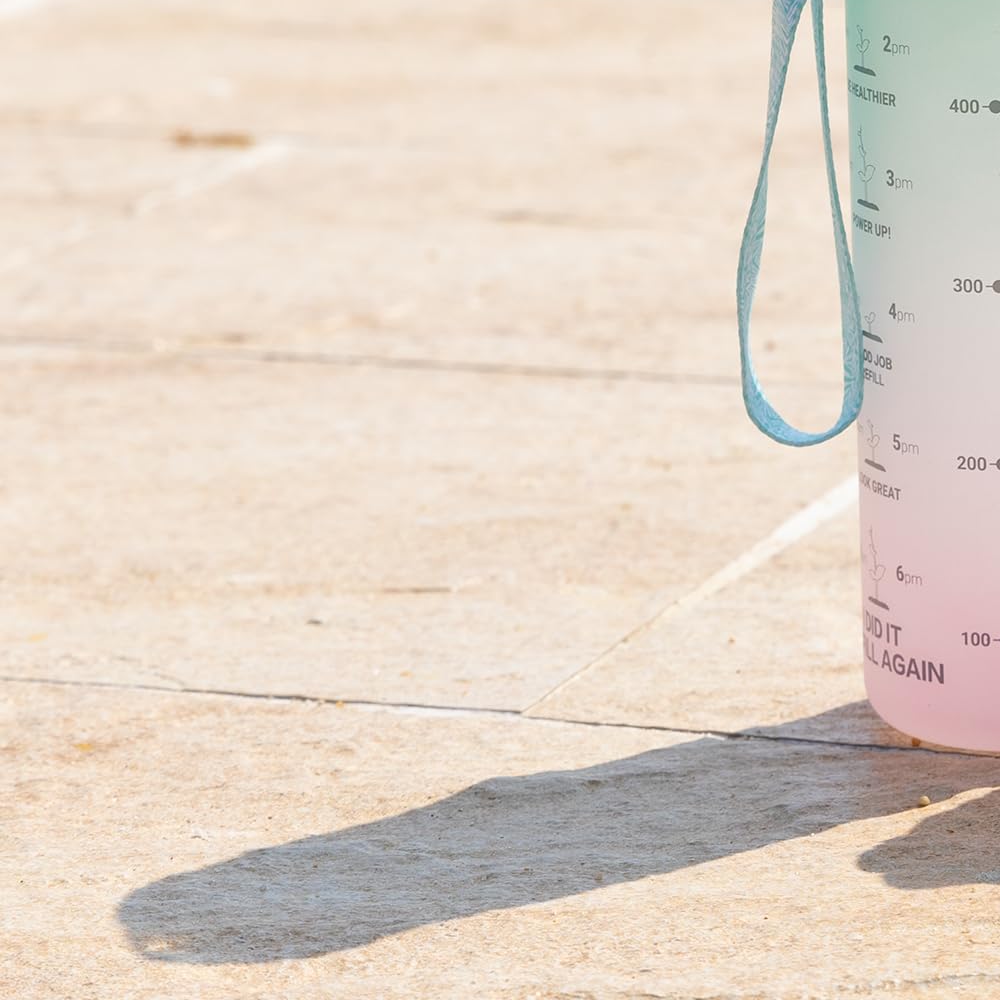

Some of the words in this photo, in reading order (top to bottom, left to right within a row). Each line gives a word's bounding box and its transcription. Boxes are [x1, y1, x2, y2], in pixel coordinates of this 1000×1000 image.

[882, 35, 910, 56] 2pm
[851, 81, 896, 107] HEALTHIER
[949, 99, 979, 114] 400
[886, 169, 913, 190] 3pm
[874, 223, 891, 239] UP!
[953, 278, 983, 293] 300
[888, 303, 915, 324] 4pm
[873, 354, 893, 370] JOB
[863, 367, 885, 386] EFILL
[892, 434, 920, 455] 5pm
[957, 456, 987, 471] 200
[871, 480, 901, 501] GREAT
[896, 565, 923, 586] 6pm
[865, 609, 883, 639] DID
[886, 622, 902, 646] IT
[961, 632, 991, 647] 100
[881, 649, 945, 685] AGAIN
